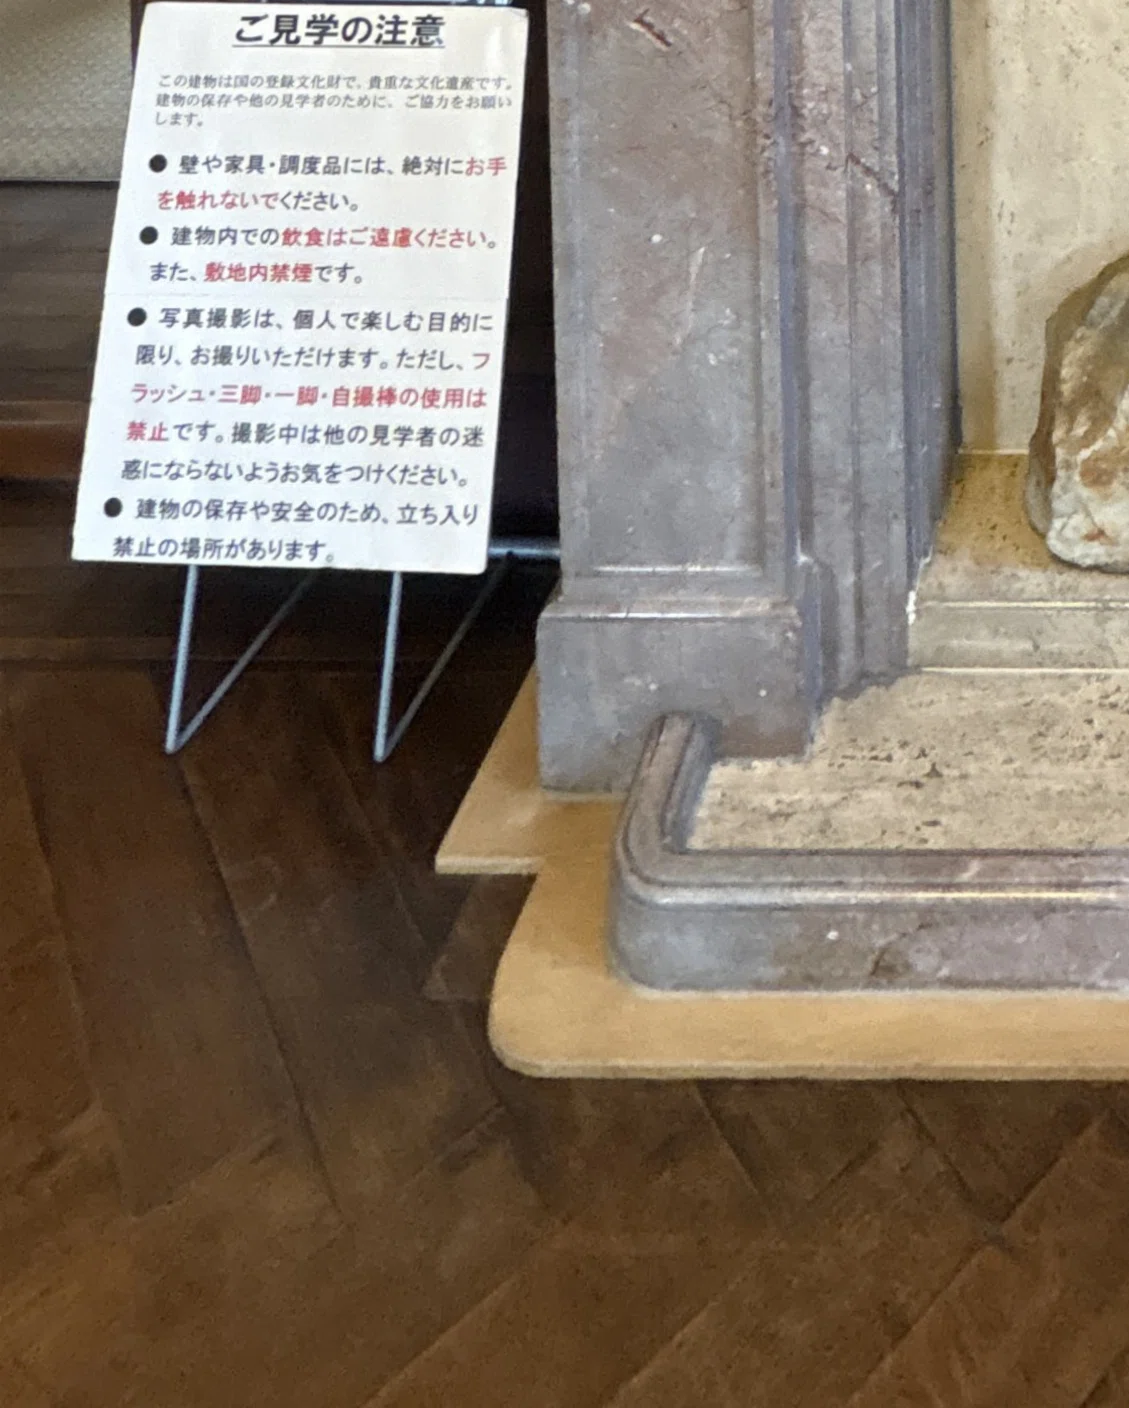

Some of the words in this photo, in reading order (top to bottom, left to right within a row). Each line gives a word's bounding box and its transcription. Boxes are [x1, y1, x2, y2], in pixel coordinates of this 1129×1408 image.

[235, 13, 446, 47] ご見学の注意
[158, 74, 513, 91] この建物は国の登録文化財で、貴重な文化遺産です。
[155, 93, 513, 110] 建物の保存や他の見学者のために、ご協力をお願い
[155, 112, 203, 127] します。
[178, 154, 507, 177] 壁や家具・調度品には、絶対にお手
[157, 190, 358, 212] を触れないでください。
[171, 225, 496, 249] 建物内での飲食はご遠慮ください。
[150, 261, 362, 284] また、敷地内禁煙です。
[158, 307, 493, 333] 写真撮影は、個人で楽しむ目的に
[135, 344, 491, 371] 限り、お撮りいただけます。ただし、フ
[131, 383, 487, 409] ラッシュ・三脚・一脚・自撮棒の使用は
[127, 420, 485, 448] 禁止です。撮影中は他の見学者の迷
[121, 458, 468, 487] 惑にならないようお気をつけください。
[136, 498, 479, 526] 建物の保存や安全のため、立ち入り
[113, 536, 334, 563] 禁止の場所があります。
